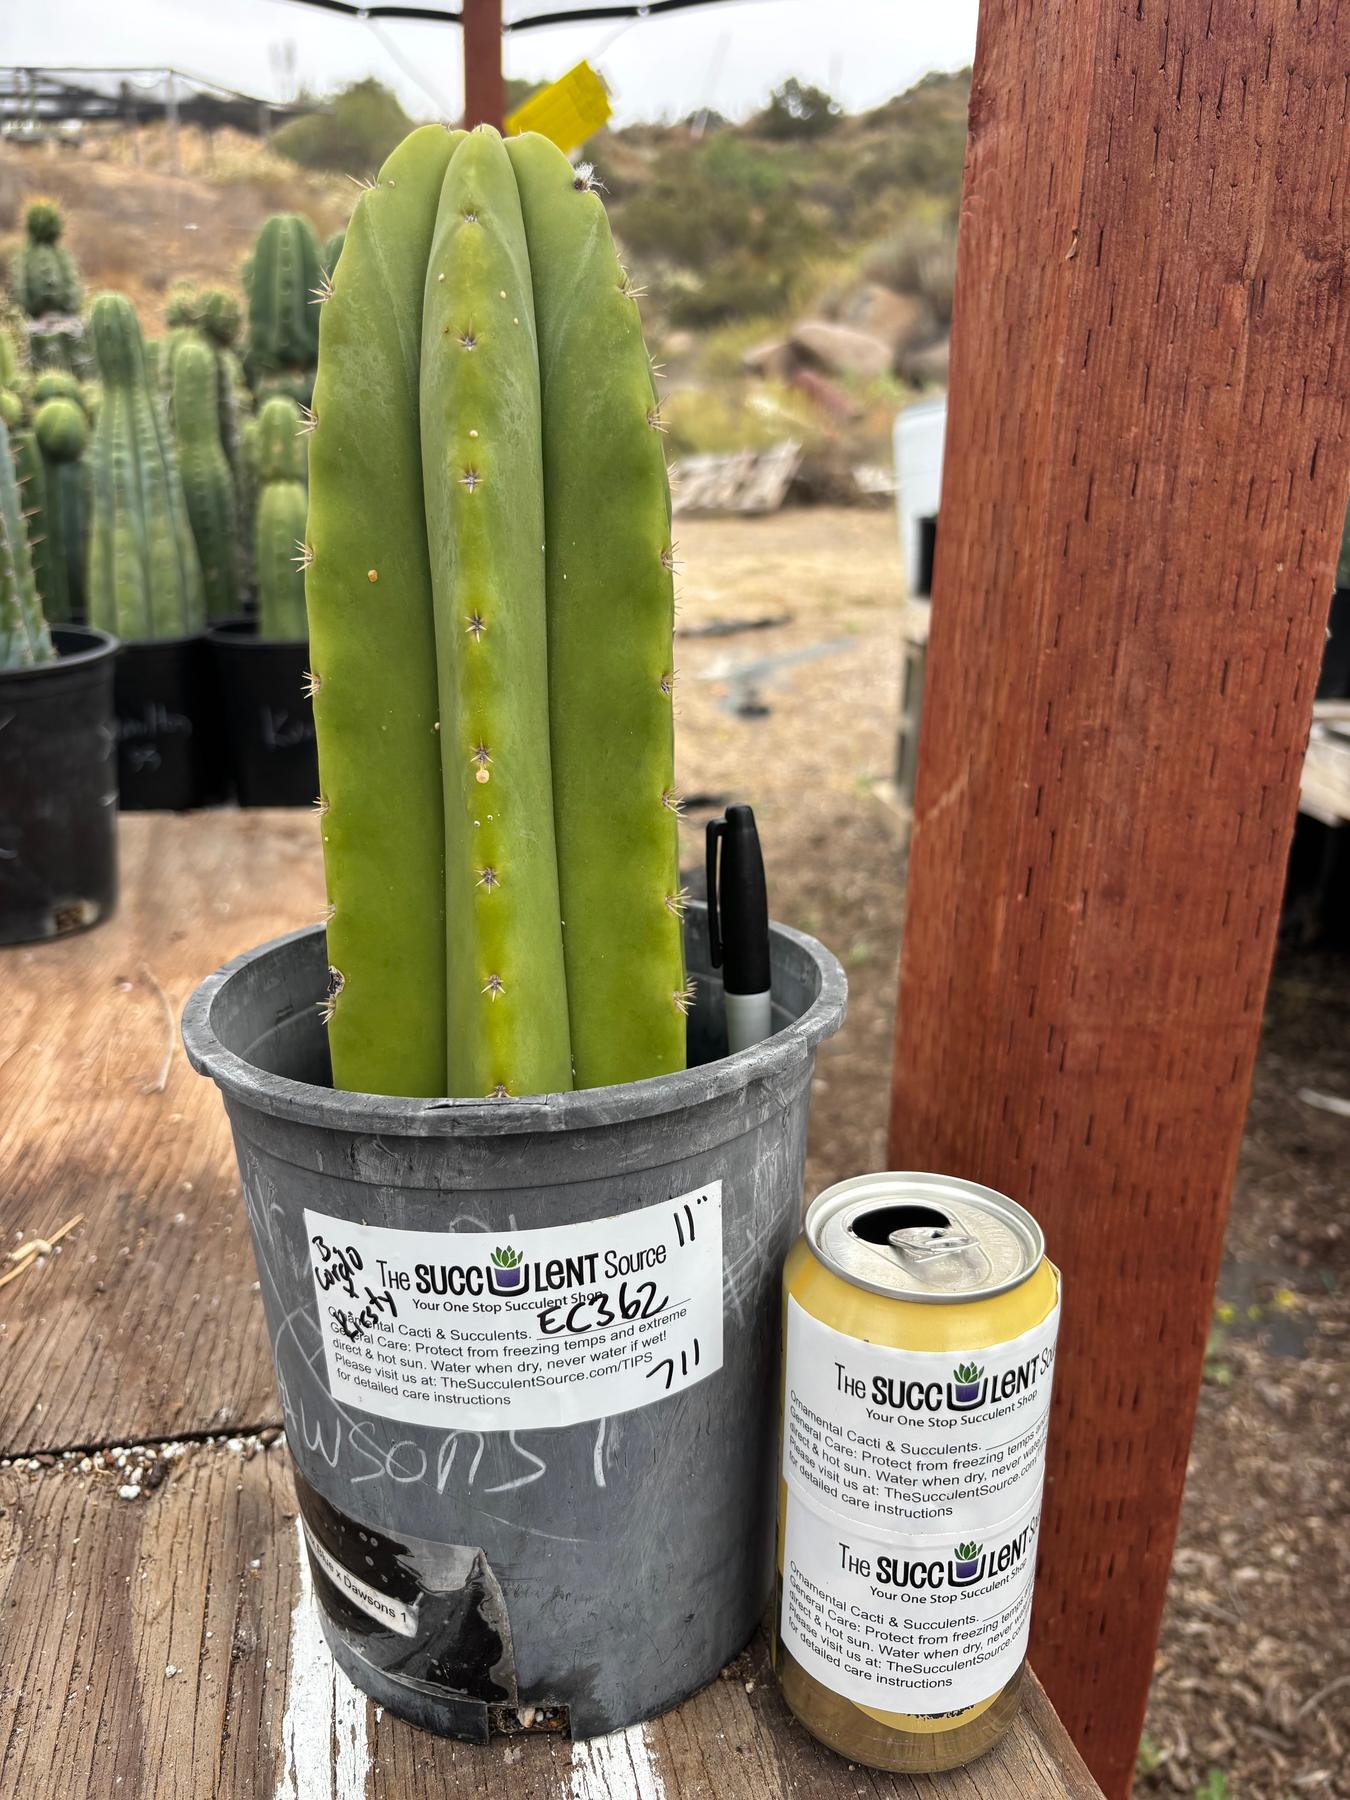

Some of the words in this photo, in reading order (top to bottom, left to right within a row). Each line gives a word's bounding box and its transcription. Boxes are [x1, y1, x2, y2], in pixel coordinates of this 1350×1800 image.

[376, 1259, 410, 1290] The
[604, 1244, 668, 1279] Source
[412, 1298, 440, 1311] Your
[443, 1301, 469, 1312] One
[472, 1302, 502, 1314] Stop
[505, 1297, 568, 1311] Succulent
[333, 1338, 362, 1356] direct
[365, 1349, 374, 1360] &
[377, 1353, 397, 1365] hot
[400, 1357, 427, 1370] sun.
[430, 1360, 471, 1373] Water
[475, 1362, 513, 1373] when
[517, 1361, 542, 1374] dry,
[547, 1355, 586, 1370] never
[590, 1345, 627, 1362] water
[631, 1340, 639, 1351] if
[641, 1330, 667, 1348] wet!
[377, 1335, 411, 1352] Care:
[415, 1343, 463, 1357] Protect
[467, 1346, 498, 1357] from
[503, 1343, 560, 1357] freezing
[564, 1334, 606, 1351] temps
[610, 1325, 635, 1341] and
[638, 1308, 687, 1333] extreme
[398, 1324, 432, 1339] Cacti
[436, 1328, 446, 1340] &
[450, 1329, 531, 1341] Succulents.
[335, 1352, 372, 1374] Please
[375, 1366, 398, 1381] visit
[402, 1374, 417, 1384] us
[421, 1376, 437, 1387] at:
[441, 1352, 653, 1389] TheSucculentSource.com/TIPS
[336, 1368, 351, 1382] for
[354, 1376, 399, 1396] detailed
[402, 1388, 430, 1401] care
[434, 1391, 511, 1405] instructions
[835, 1362, 866, 1400] The
[791, 1390, 843, 1437] Ornamental
[847, 1430, 881, 1449] Cacti
[885, 1440, 895, 1452] &
[901, 1442, 982, 1455] Succulents.
[866, 1408, 894, 1424] Your
[897, 1415, 924, 1427] One
[928, 1417, 957, 1429] Stop
[961, 1403, 1015, 1425] Succulent
[1017, 1389, 1038, 1409] Shop
[790, 1405, 821, 1441] General
[825, 1435, 857, 1458] Care:
[862, 1451, 912, 1470] Protect
[916, 1460, 948, 1471] from
[953, 1450, 1004, 1469] freezing
[1007, 1430, 1034, 1456] temps
[790, 1422, 810, 1448] direct
[811, 1443, 819, 1456] &
[822, 1449, 840, 1468] hot
[844, 1463, 871, 1478] sun.
[876, 1469, 918, 1486] Water
[922, 1476, 959, 1487] when
[964, 1471, 987, 1485] dry,
[991, 1455, 1021, 1478] never
[789, 1435, 815, 1468] Please
[818, 1464, 840, 1484] visit
[843, 1478, 858, 1490] us
[862, 1484, 879, 1496] at:
[789, 1450, 798, 1467] for
[800, 1465, 838, 1498] detailed
[841, 1493, 870, 1509] care
[874, 1501, 953, 1519] instructions
[839, 1542, 870, 1578] The
[869, 1586, 897, 1600] Your
[900, 1593, 927, 1604] One
[930, 1594, 957, 1604] Stop
[960, 1575, 1009, 1600] Succulent
[1011, 1558, 1027, 1580] Shop
[343, 1573, 396, 1618] Dawsons
[400, 1612, 407, 1623] 1
[789, 1575, 824, 1614] General
[827, 1609, 860, 1632] Care:
[865, 1626, 914, 1645] Protect
[918, 1635, 948, 1645] from
[952, 1621, 999, 1642] freezing
[790, 1560, 846, 1611] Ornamental
[850, 1605, 883, 1624] Cacti
[888, 1617, 898, 1628] &
[903, 1614, 979, 1630] Succulents.
[789, 1590, 811, 1619] direct
[814, 1614, 822, 1628] &
[825, 1622, 843, 1640] hot
[847, 1634, 874, 1652] sun.
[879, 1644, 919, 1660] Water
[923, 1649, 958, 1660] when
[963, 1642, 984, 1655] dry,
[987, 1621, 1013, 1646] never
[789, 1602, 817, 1637] Please
[820, 1635, 843, 1654] visit
[846, 1649, 861, 1662] us
[865, 1655, 882, 1669] at:
[788, 1616, 798, 1634] for
[800, 1632, 841, 1667] detailed
[844, 1663, 872, 1681] care
[876, 1673, 953, 1689] instructions
